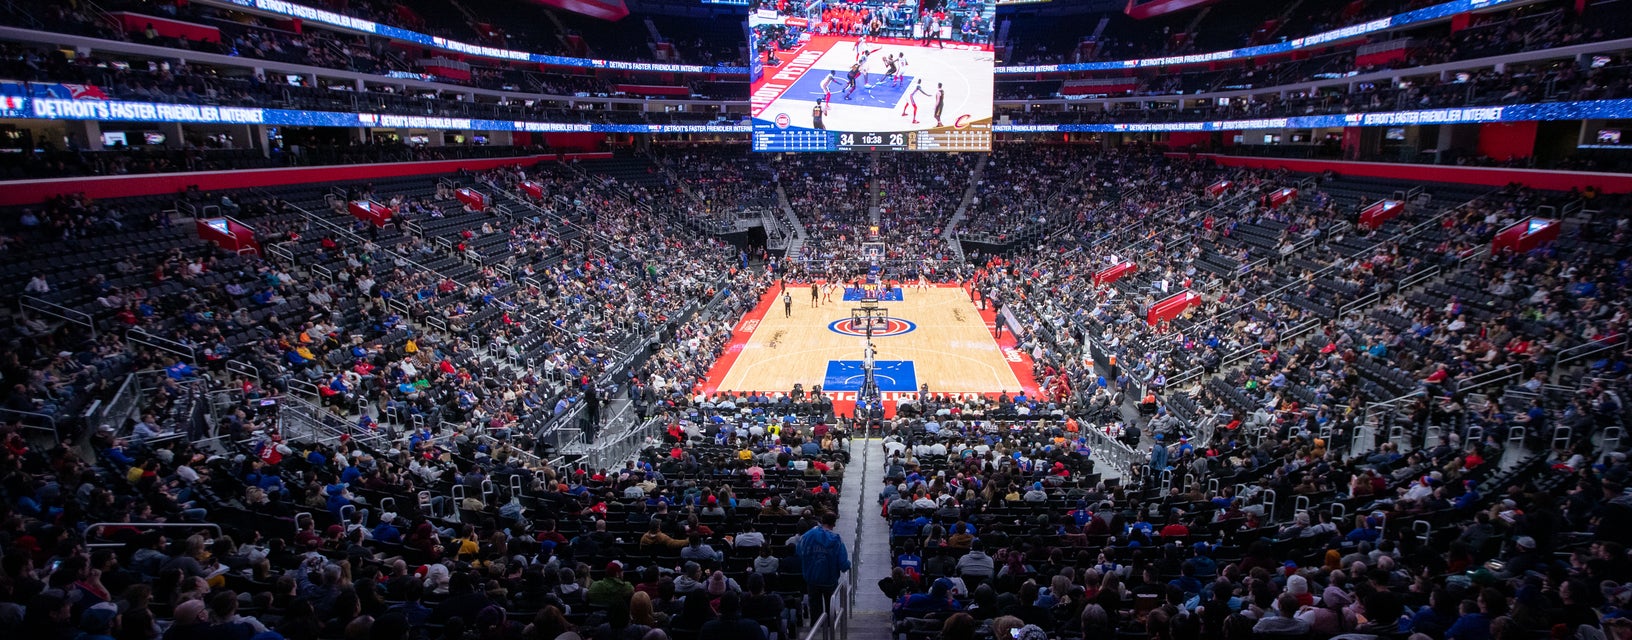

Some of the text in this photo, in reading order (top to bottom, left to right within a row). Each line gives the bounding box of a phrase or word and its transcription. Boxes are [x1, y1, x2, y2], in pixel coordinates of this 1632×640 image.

[293, 3, 317, 20] FASTER
[1141, 51, 1233, 66] DETROIT'S FASTER FRIENDLIER INTERNET
[609, 61, 632, 69] DETROIT'S
[652, 64, 680, 72] FRIENDLIER
[681, 65, 703, 73] INTERNET
[1007, 65, 1035, 73] FRIENDLIER
[34, 98, 108, 119] DETROIT'S
[110, 101, 156, 121] FASTER
[158, 104, 219, 122] FRIENDLIER
[221, 107, 264, 123] INTERNET
[1364, 107, 1504, 125] DETROIT'S FASTER FRIENDLIER INTERNET
[840, 134, 855, 146] 34
[862, 136, 882, 144] 10:38
[889, 134, 903, 146] 26
